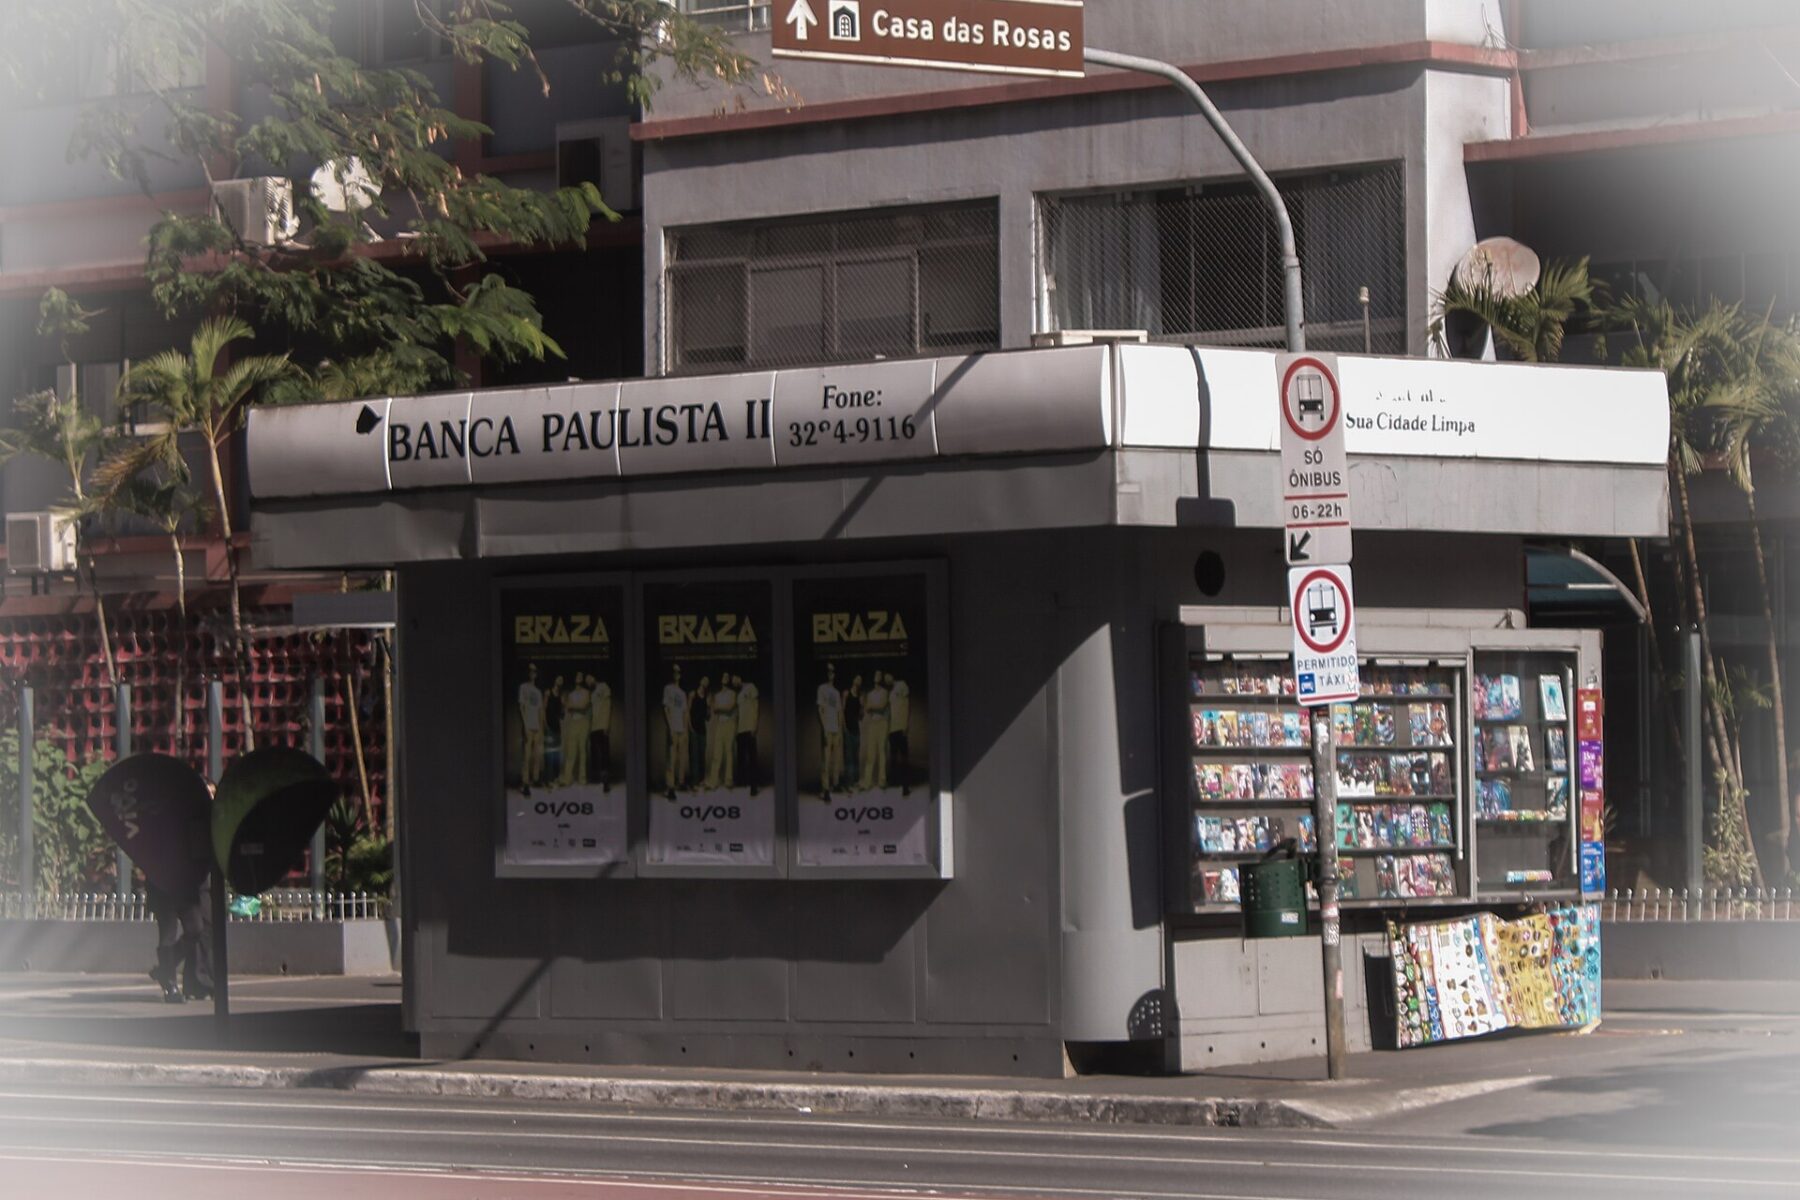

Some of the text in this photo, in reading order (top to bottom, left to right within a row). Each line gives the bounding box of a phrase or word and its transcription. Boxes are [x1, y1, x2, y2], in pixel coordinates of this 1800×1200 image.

[872, 9, 1072, 51] Casa das Rosas
[821, 384, 882, 410] Fone:
[389, 398, 771, 462] BANCA PAULISTA II
[1346, 411, 1475, 437] Sua Cidade Limpa
[1303, 445, 1323, 465] SÓ
[514, 614, 609, 644] BRAZA
[657, 613, 758, 644] BRAZA
[812, 610, 909, 644] BRAZA
[1297, 655, 1356, 671] PERMITIDO
[1319, 671, 1345, 687] TÁXI
[533, 801, 594, 818] 01/08
[679, 805, 742, 823] 01/08
[833, 806, 895, 824] 01/08
